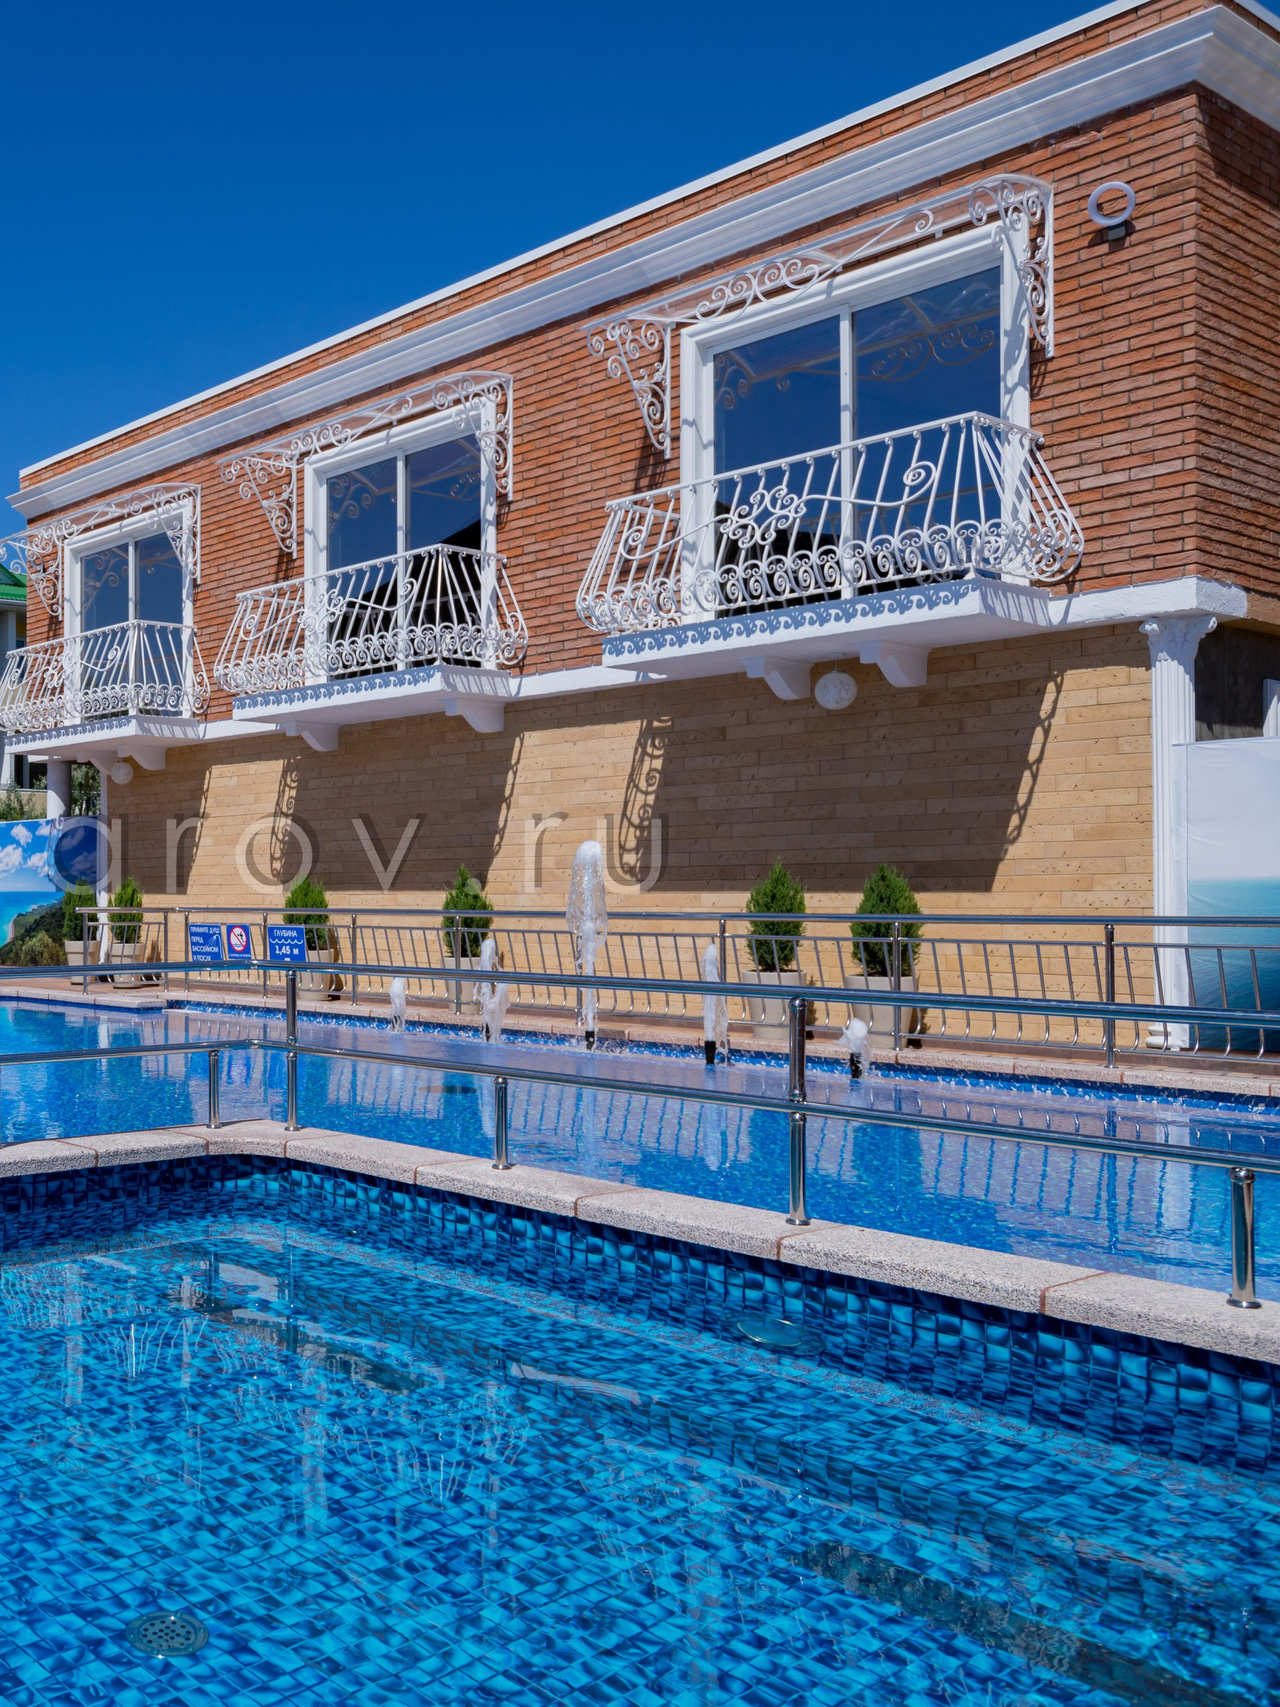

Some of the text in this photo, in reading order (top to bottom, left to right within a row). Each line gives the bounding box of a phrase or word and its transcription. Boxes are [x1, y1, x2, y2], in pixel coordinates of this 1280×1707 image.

[274, 929, 298, 937] ГЛУБИНА
[192, 945, 219, 953] БАССЕЙНОМ
[275, 945, 291, 955] 1,45
